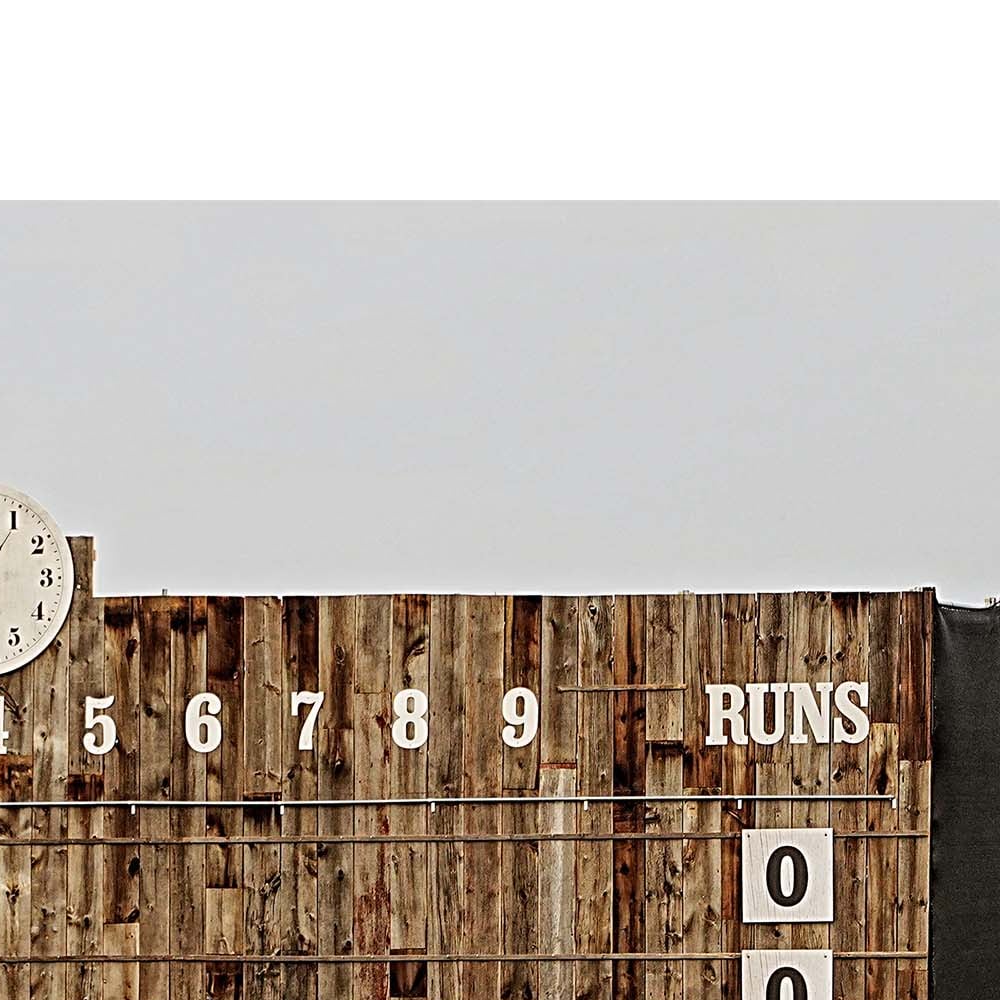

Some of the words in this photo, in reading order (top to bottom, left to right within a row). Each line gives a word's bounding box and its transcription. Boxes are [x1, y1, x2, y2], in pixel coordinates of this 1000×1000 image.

[9, 510, 18, 530] 1
[31, 535, 44, 555] 2
[39, 568, 53, 587] 3
[31, 601, 45, 621] 4
[8, 627, 20, 647] 5
[83, 695, 117, 755] 5
[184, 692, 222, 753] 6
[290, 691, 324, 751] 7
[391, 688, 429, 750] 8
[502, 686, 539, 748] 9
[704, 681, 870, 746] RUNS
[765, 845, 808, 907] 0
